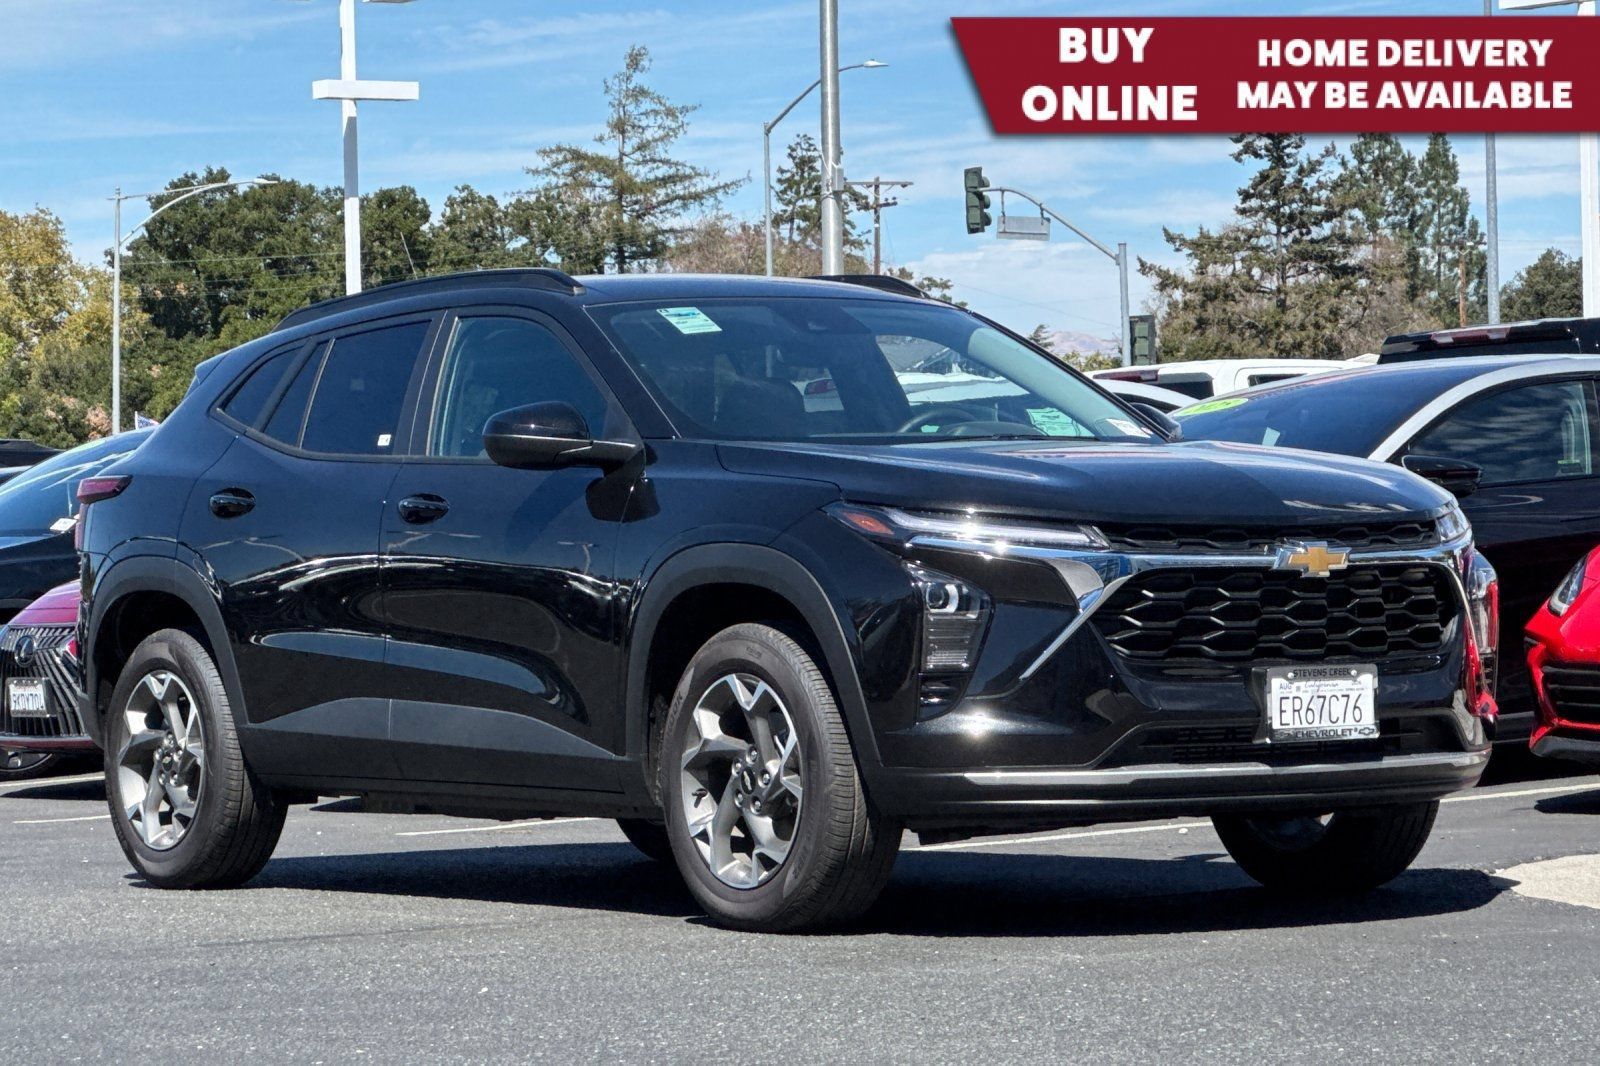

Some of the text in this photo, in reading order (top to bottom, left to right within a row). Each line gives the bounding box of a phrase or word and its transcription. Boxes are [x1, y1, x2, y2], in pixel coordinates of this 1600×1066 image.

[1293, 667, 1352, 679] STEVENS CREEK
[1279, 693, 1363, 726] ER67C76
[1295, 728, 1354, 739] CHEVROLET
